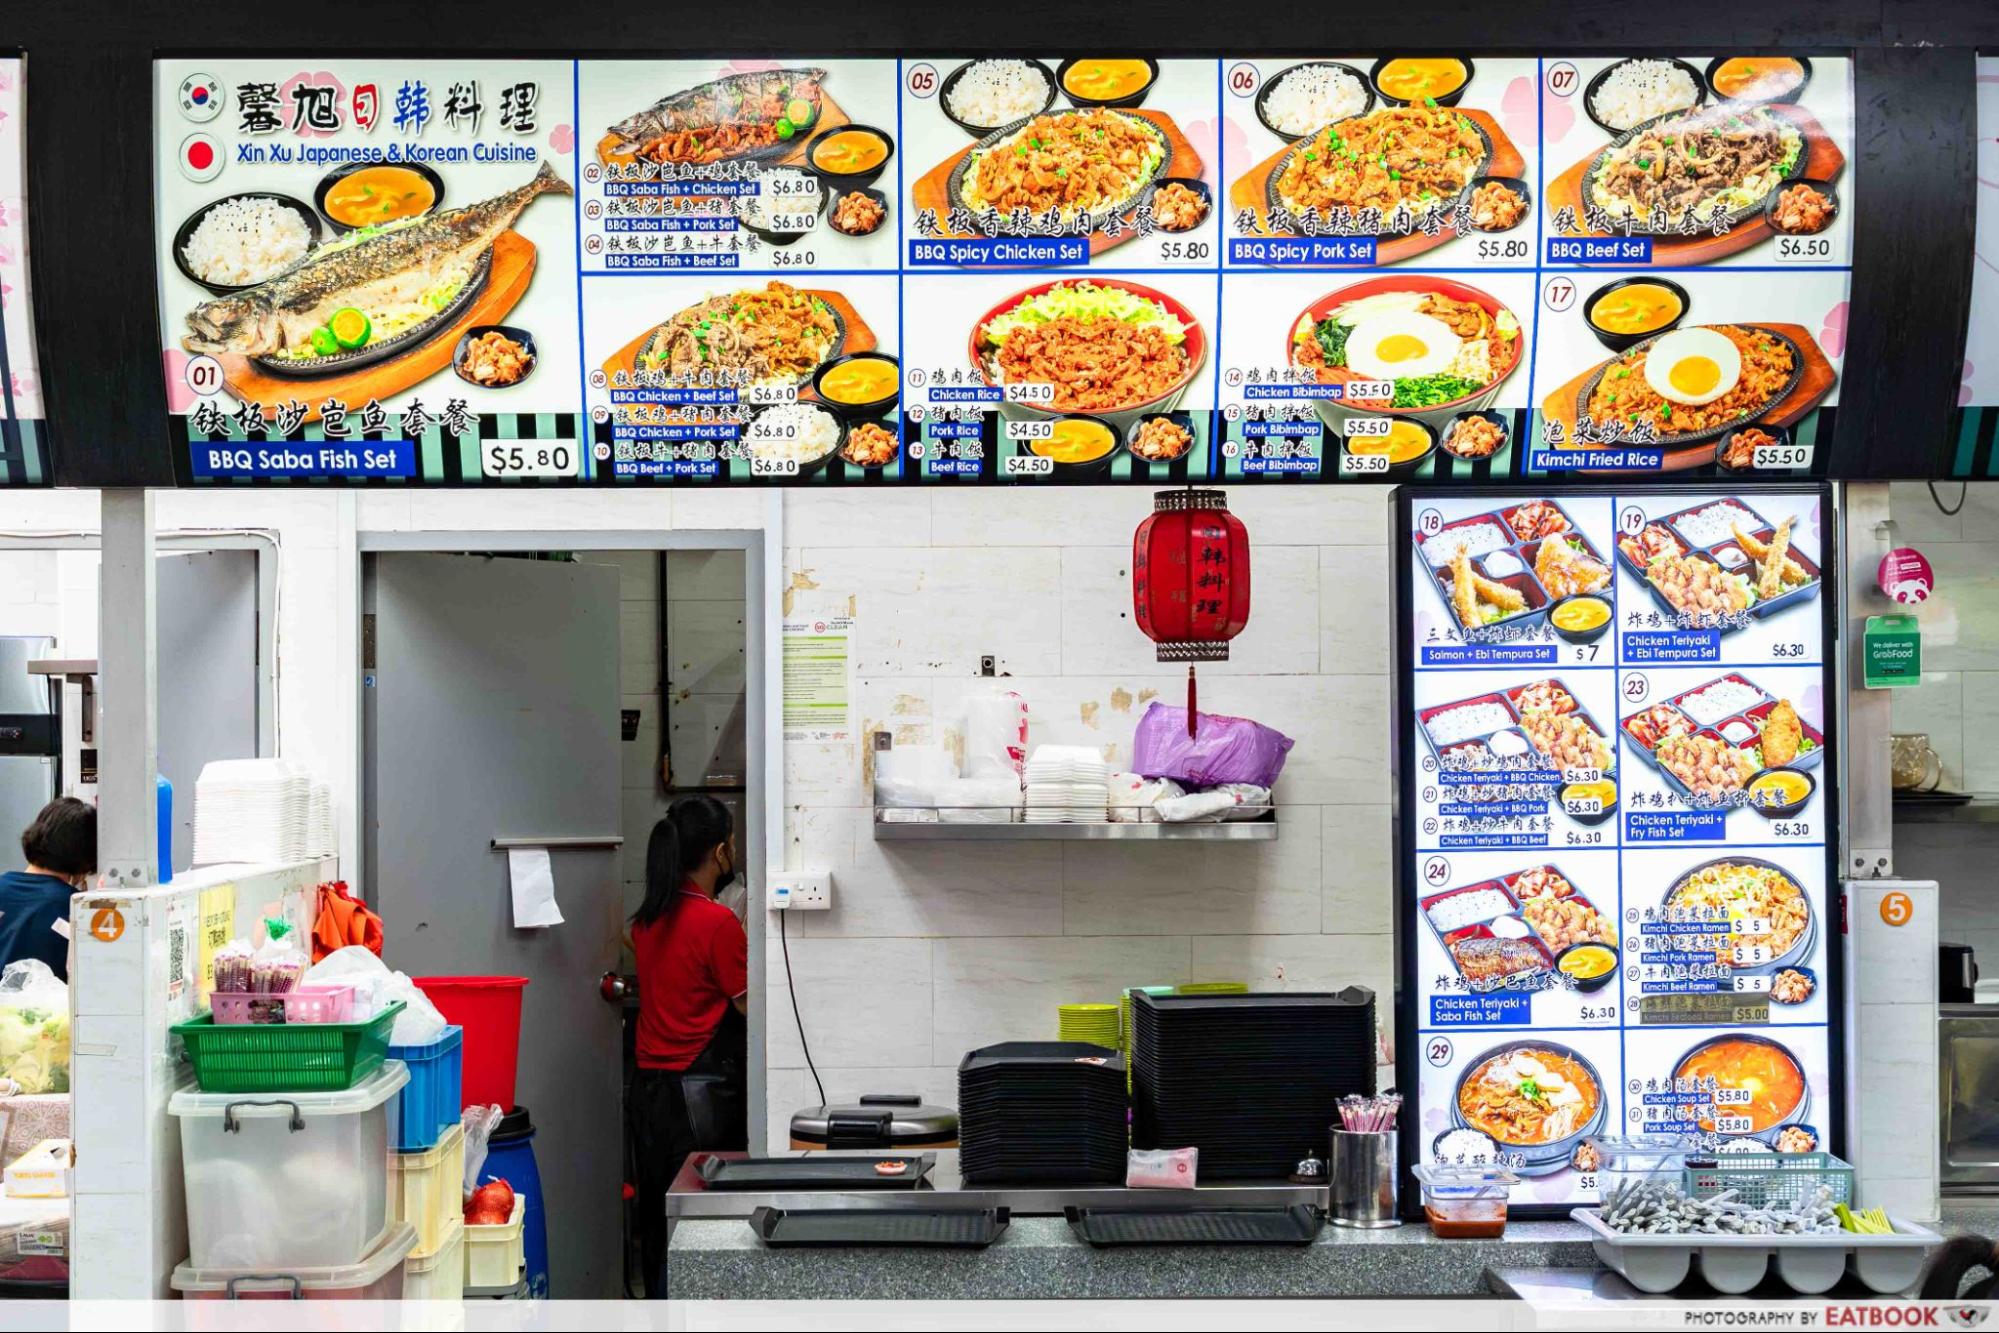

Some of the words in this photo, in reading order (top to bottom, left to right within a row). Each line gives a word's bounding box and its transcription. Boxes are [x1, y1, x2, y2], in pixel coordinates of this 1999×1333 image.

[912, 73, 933, 89] 05
[1233, 72, 1253, 88] 06
[1552, 71, 1574, 88] 07
[238, 143, 264, 162] Xin
[269, 143, 292, 162] Xu
[297, 143, 381, 166] Japanese
[387, 144, 401, 162] &
[405, 143, 468, 162] Korean
[473, 143, 536, 162] Cuisine
[587, 169, 598, 177] 02
[606, 184, 628, 195] BBQ
[631, 184, 658, 194] Saba
[661, 184, 680, 194] Fish
[692, 183, 737, 194] Chicken
[739, 183, 755, 194] Set
[773, 179, 814, 193] $6.80
[588, 206, 599, 214] 03
[607, 220, 628, 231] BBQ
[631, 220, 658, 230] Saba
[662, 219, 680, 230] Fish
[693, 219, 715, 230] Pork
[718, 219, 734, 230] Set
[773, 215, 815, 229] $6.80
[589, 240, 600, 249] 04
[1478, 241, 1528, 259] $5.80
[1551, 244, 1581, 258] BBQ
[1586, 243, 1618, 257] Beef
[1622, 243, 1645, 257] Set
[1780, 239, 1830, 257] $6.50
[773, 251, 815, 265] $6.80
[915, 247, 945, 261] BBQ
[949, 245, 988, 262] Spicy
[992, 245, 1055, 260] Chicken
[1059, 245, 1082, 259] Set
[1161, 242, 1209, 261] $5.80
[1235, 245, 1265, 259] BBQ
[1269, 243, 1308, 260] Spicy
[1314, 243, 1344, 258] Pork
[1350, 243, 1372, 258] Set
[608, 256, 629, 267] BBQ
[632, 256, 658, 266] Saba
[662, 256, 681, 266] Fish
[694, 255, 716, 266] Beef
[720, 255, 735, 266] Set
[1551, 286, 1571, 302] 17
[193, 366, 216, 386] 01
[592, 374, 604, 384] 08
[912, 374, 922, 382] 11
[1228, 373, 1239, 381] 14
[755, 387, 795, 401] $6.80
[931, 390, 974, 400] Chicken
[978, 389, 999, 400] Rice
[1010, 386, 1050, 400] $4.50
[1247, 388, 1290, 398] Chicken
[1293, 386, 1342, 399] Bibimbap
[1350, 382, 1390, 396] $5.50
[614, 391, 635, 402] BBQ
[638, 390, 681, 402] Chicken
[693, 390, 716, 401] Beef
[719, 390, 734, 401] Set
[594, 410, 605, 420] 09
[912, 409, 922, 418] 12
[1228, 409, 1238, 418] 15
[615, 427, 636, 438] BBQ
[639, 427, 682, 437] Chicken
[694, 427, 716, 437] Pork
[719, 426, 735, 437] Set
[755, 423, 795, 438] $6.80
[932, 426, 954, 436] Pork
[957, 426, 978, 435] Rice
[1010, 423, 1050, 437] $4.50
[1245, 424, 1268, 434] Pork
[1271, 424, 1319, 436] Bibimbap
[1348, 421, 1388, 434] $5.50
[1543, 418, 1657, 445] 泡菜炒饭
[596, 446, 607, 456] 10
[912, 446, 923, 454] 13
[1225, 445, 1236, 454] 16
[209, 450, 253, 470] BBQ
[258, 450, 313, 469] Saba
[319, 449, 358, 469] Fish
[364, 449, 396, 469] Set
[491, 447, 570, 473] $5.80
[1346, 456, 1386, 470] $5.50
[1537, 453, 1585, 468] Kimchi
[1589, 453, 1623, 466] Fried
[1626, 452, 1658, 466] Rice
[1757, 448, 1806, 467] $5.50
[617, 463, 637, 474] BBQ
[640, 463, 663, 473] Beef
[675, 463, 697, 473] Pork
[700, 463, 715, 473] Set
[755, 459, 795, 473] $6.80
[931, 462, 953, 471] Beef
[957, 462, 977, 471] Rice
[1009, 459, 1049, 472] $4.50
[1244, 460, 1266, 470] Beef
[1270, 460, 1317, 471] Bibimbap
[1424, 516, 1439, 529] 18
[1626, 515, 1641, 528] 19
[1627, 636, 1669, 646] Chicken
[1672, 636, 1710, 646] Teriyaki
[1429, 651, 1464, 659] Salmon
[1476, 649, 1489, 658] Ebi
[1492, 650, 1533, 660] Tempura
[1536, 649, 1550, 658] Set
[1637, 648, 1651, 658] Ebi
[1654, 648, 1698, 660] Tempura
[1701, 647, 1716, 657] Set
[1773, 644, 1804, 657] $6.30
[1873, 649, 1913, 659] GrabFood
[1627, 681, 1644, 694] 23
[1631, 815, 1672, 825] Chicken
[1675, 815, 1713, 826] Teriyaki
[1631, 828, 1644, 839] Fry
[1648, 828, 1665, 837] Fish
[1670, 828, 1684, 837] Set
[1774, 824, 1809, 836] $6.30
[1429, 864, 1446, 878] 24
[1888, 896, 1906, 921] 5
[98, 912, 117, 937] 4
[1436, 999, 1477, 1009] Chicken
[1481, 999, 1519, 1011] Teriyaki
[1436, 1010, 1462, 1021] Saba
[1465, 1010, 1483, 1021] Fish
[1486, 1010, 1500, 1020] Set
[1581, 1007, 1615, 1019] $6.30
[1431, 1045, 1448, 1059] 29
[1678, 1095, 1695, 1104] Soup
[1718, 1091, 1749, 1102] $5.80
